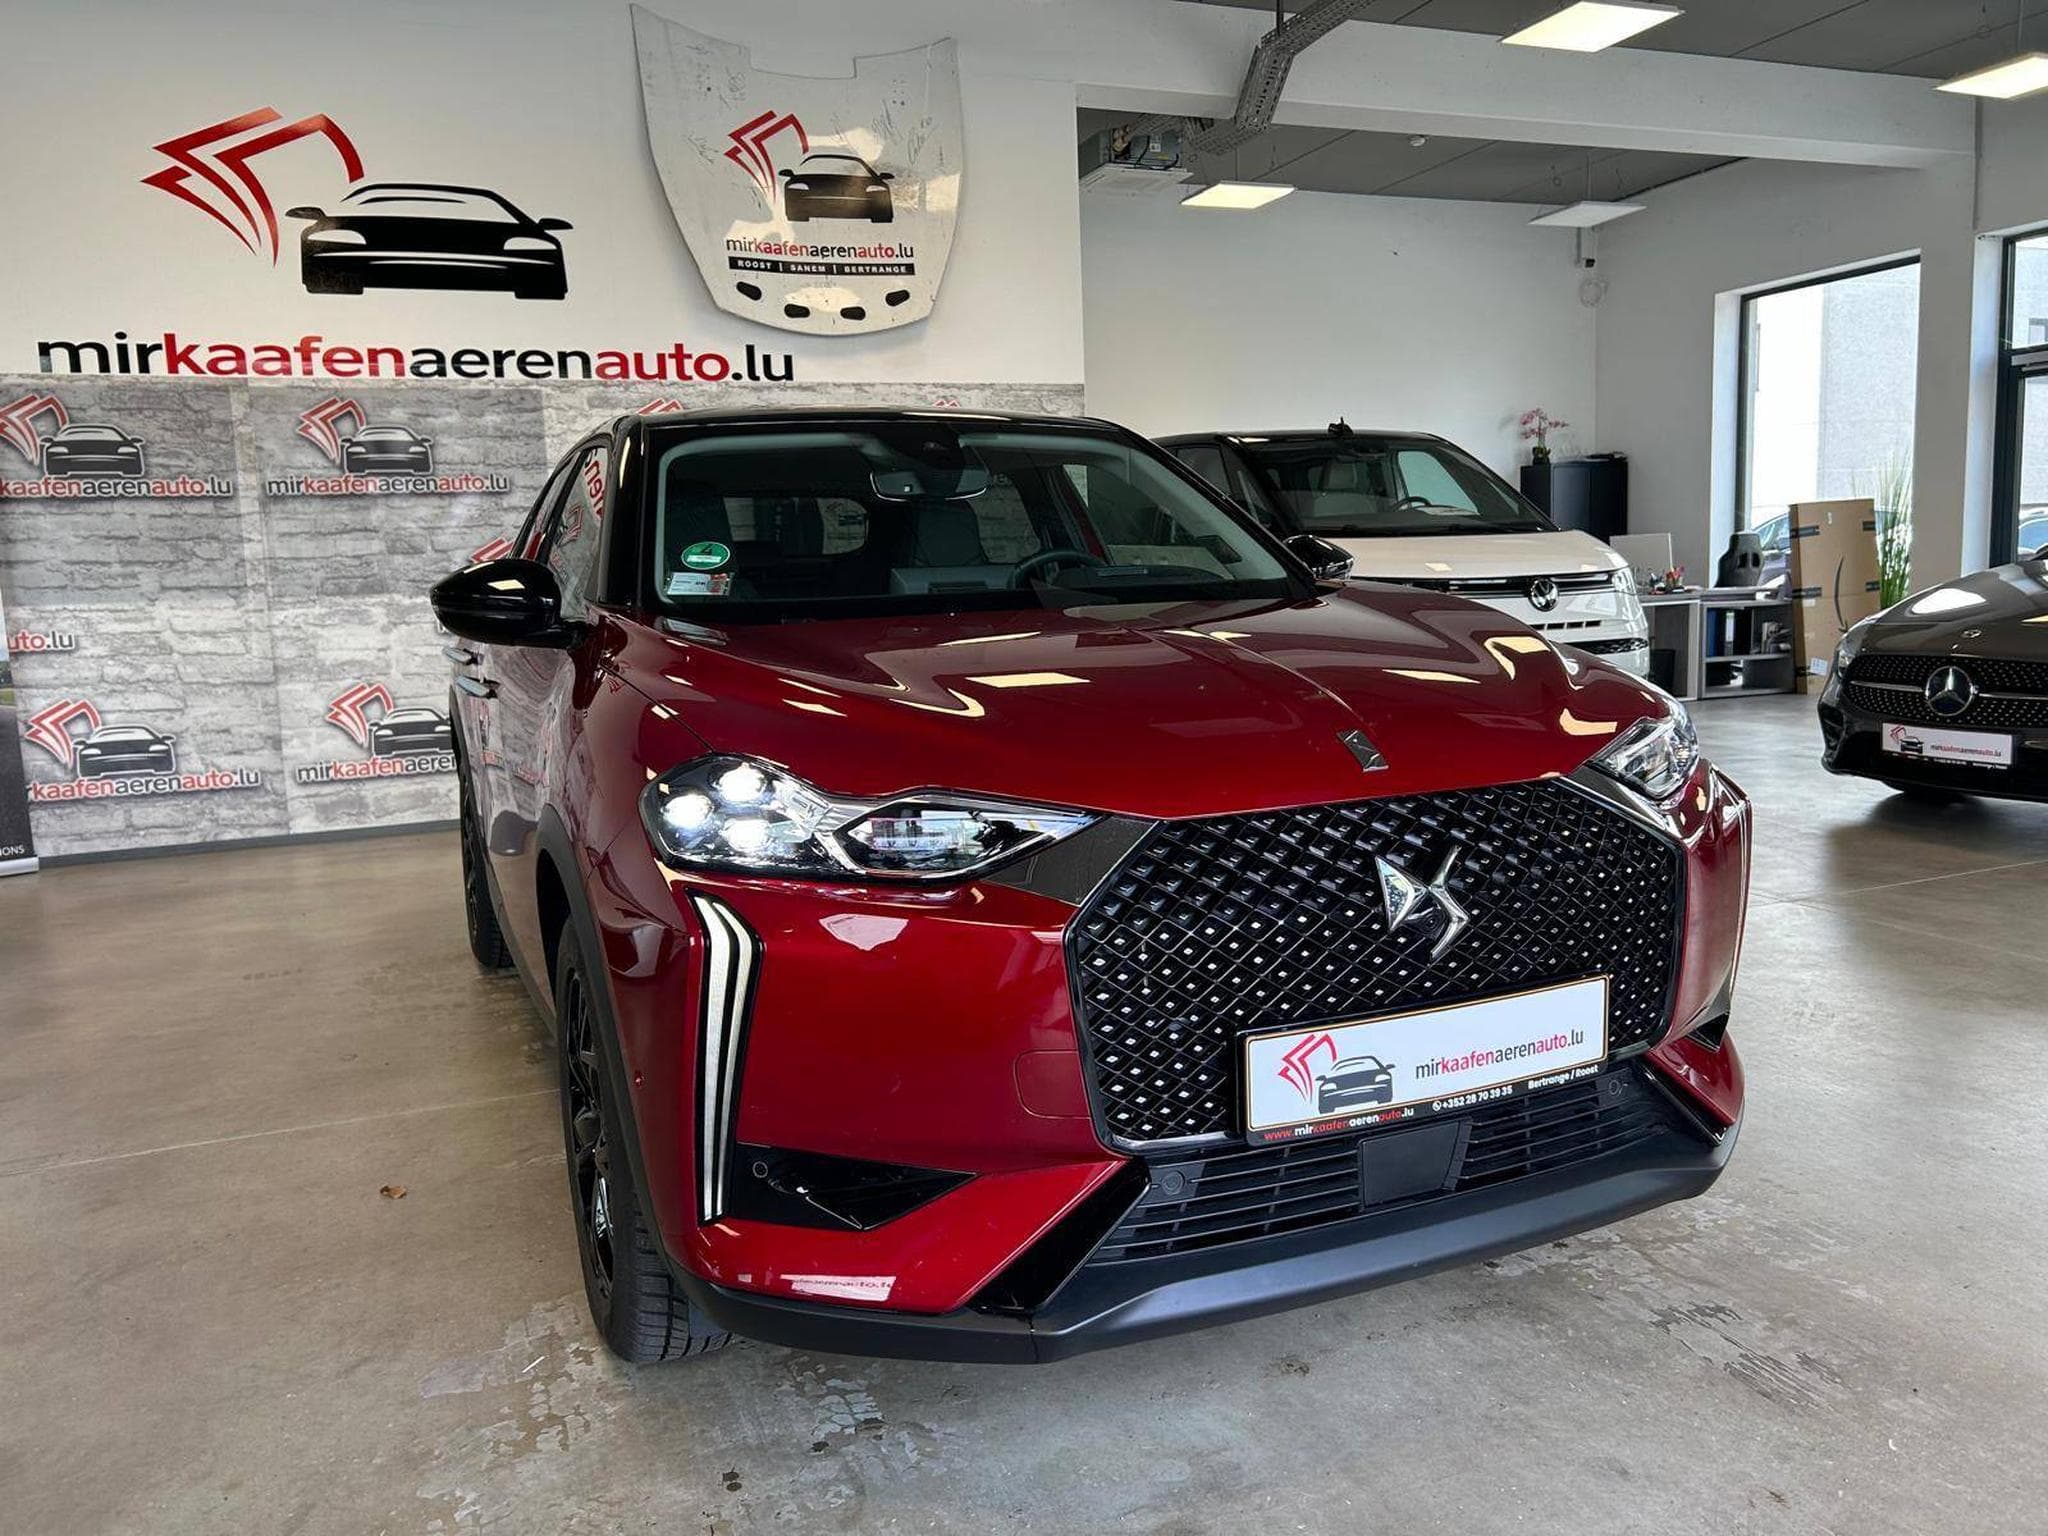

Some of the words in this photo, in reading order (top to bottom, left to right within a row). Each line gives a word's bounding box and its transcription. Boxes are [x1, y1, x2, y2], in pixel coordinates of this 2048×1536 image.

[727, 237, 914, 259] mirkaafenaerenauto.lu
[737, 260, 772, 270] ROOST
[790, 264, 826, 273] SANEM
[844, 265, 907, 273] BERTRANGE
[38, 332, 795, 382] mirkaafenaerenauto.lu
[267, 473, 508, 494] mirkaafenaerenauto.lu
[1416, 1029, 1584, 1080] mirkaafenaerenauto.lu
[1528, 1073, 1569, 1090] Bertrange
[1575, 1065, 1599, 1078] Roost
[1442, 1096, 1464, 1110] +352
[1478, 1091, 1489, 1102] 70
[1501, 1085, 1513, 1096] 35
